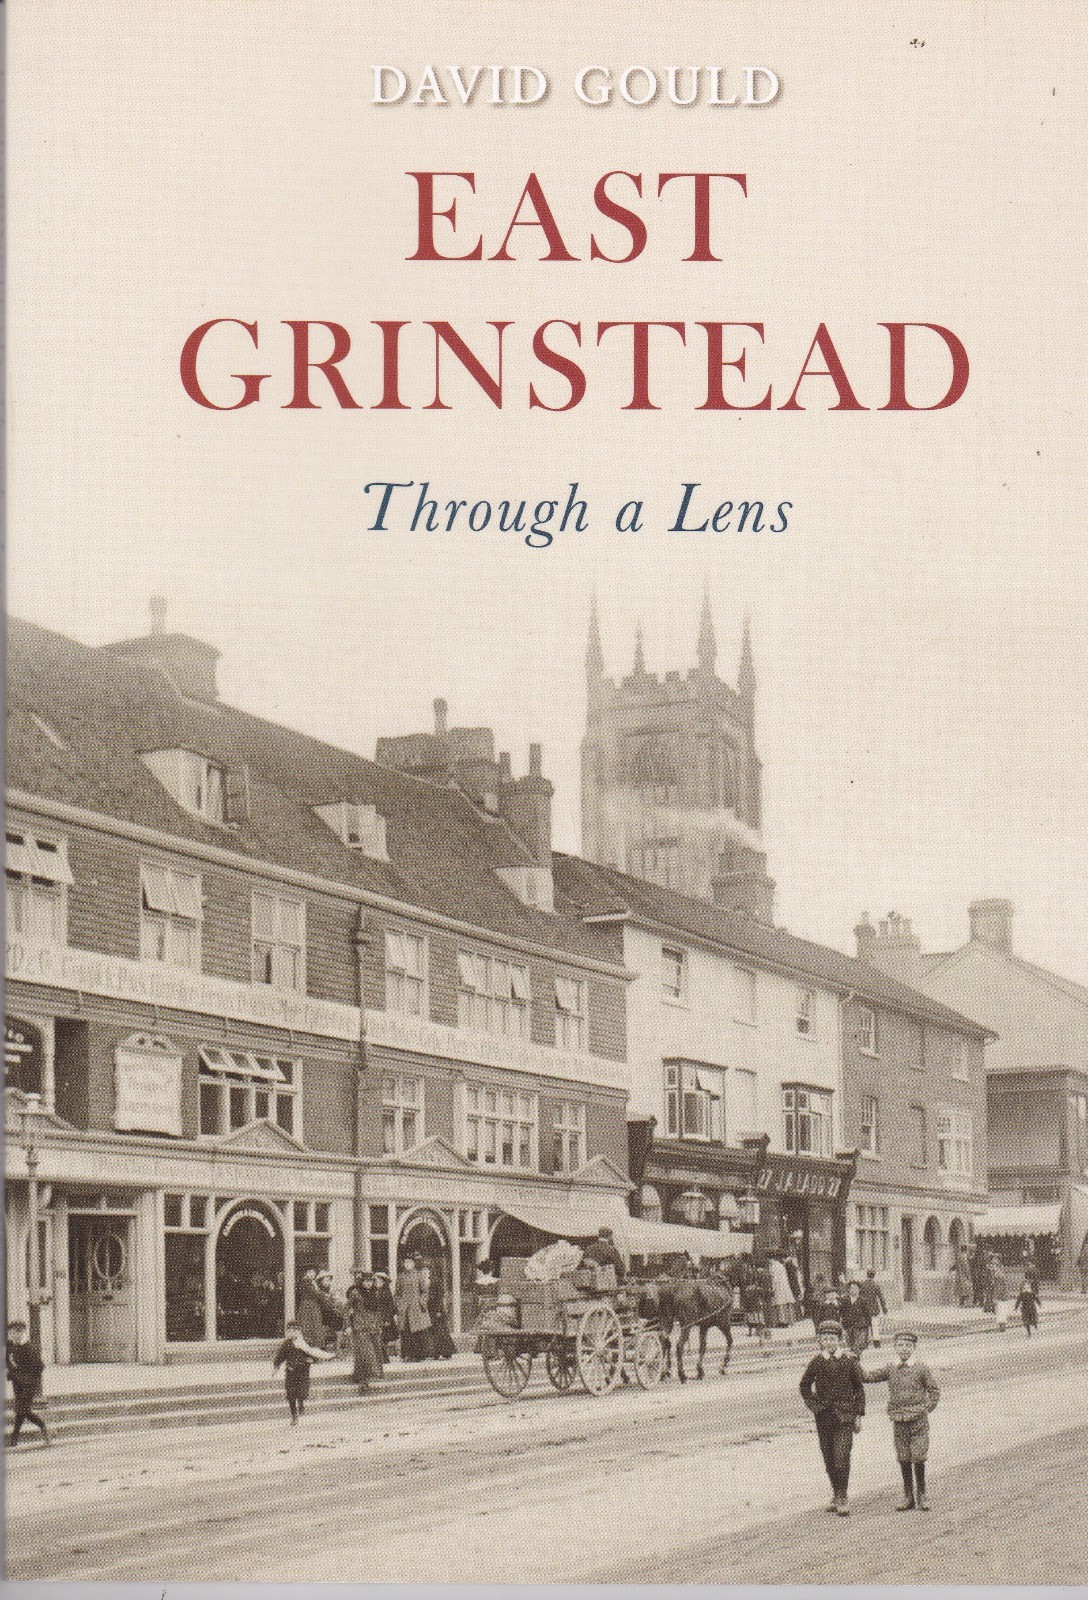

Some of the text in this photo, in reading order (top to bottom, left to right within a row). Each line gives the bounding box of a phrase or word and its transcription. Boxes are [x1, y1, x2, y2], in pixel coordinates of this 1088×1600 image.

[370, 65, 781, 106] DAVID GOULD
[406, 171, 749, 264] EAST
[179, 318, 970, 412] GRINSTEAD
[363, 481, 793, 549] Through a Lens
